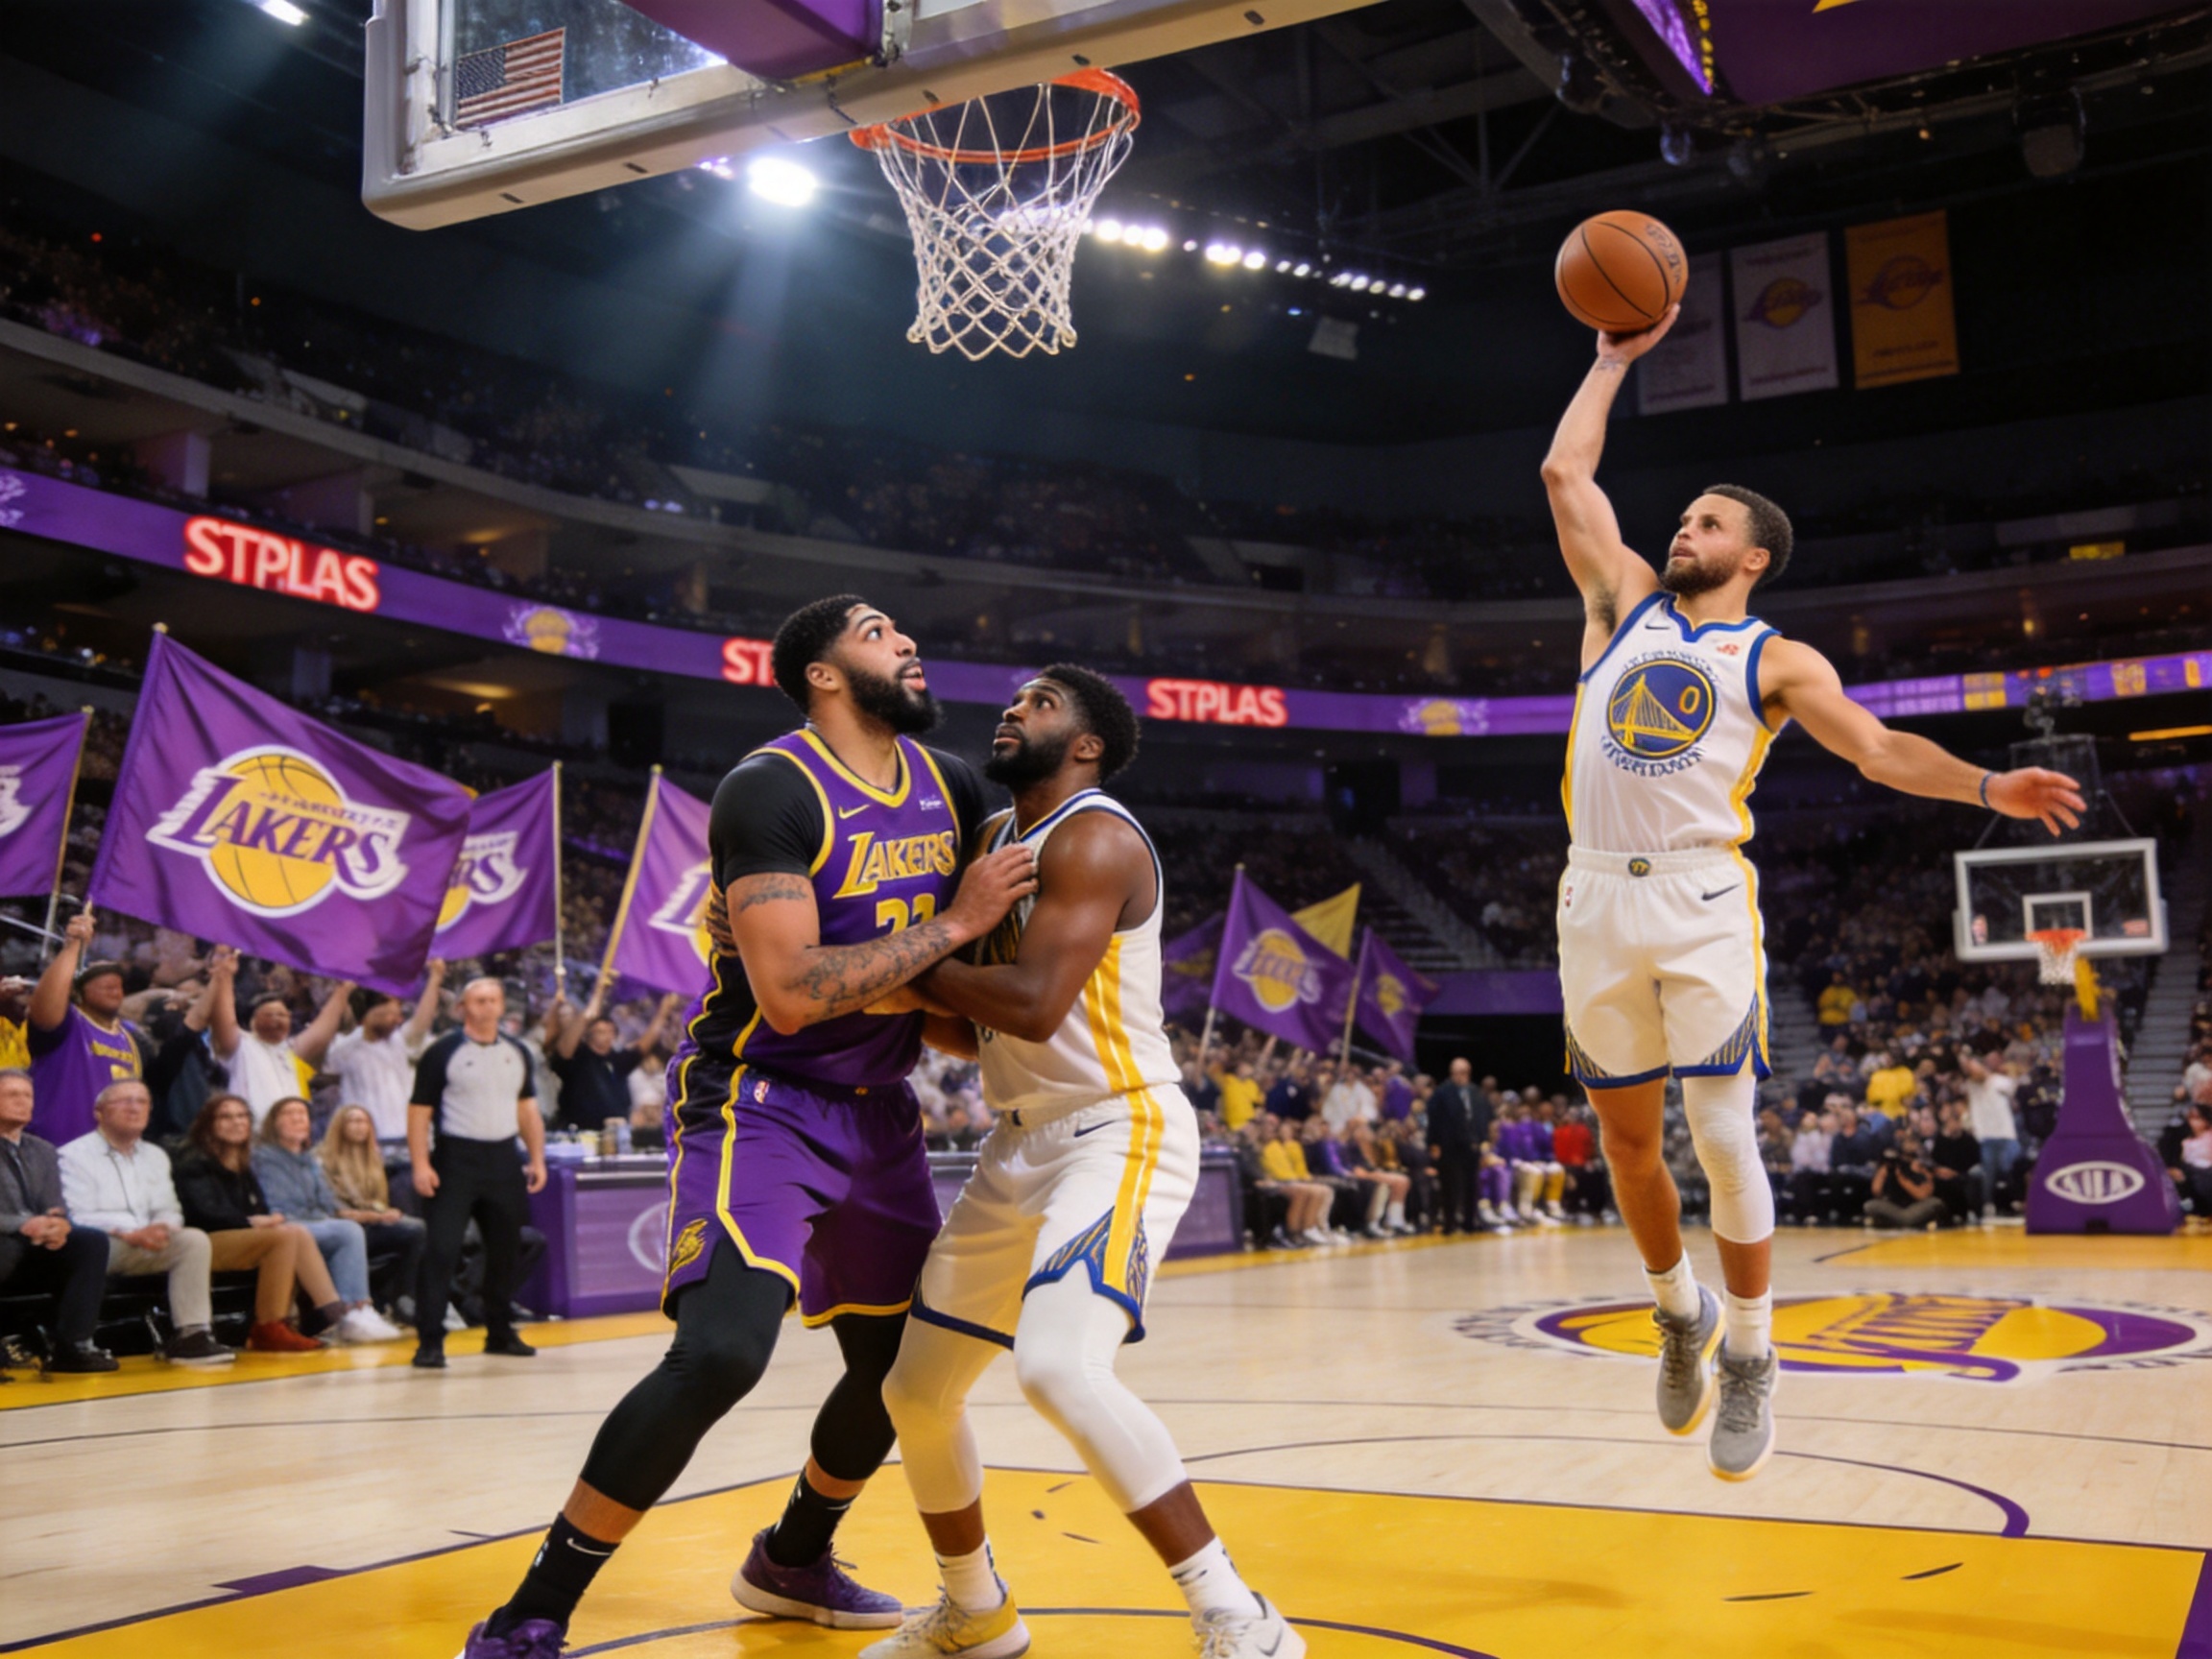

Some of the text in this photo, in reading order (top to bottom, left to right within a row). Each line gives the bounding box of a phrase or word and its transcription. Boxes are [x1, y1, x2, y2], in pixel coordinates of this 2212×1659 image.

[184, 515, 380, 613] STPLAS
[722, 637, 775, 686] ST
[1147, 678, 1287, 728] STPLAS
[1679, 685, 1700, 714] 0
[161, 775, 391, 890] LAKERS
[831, 830, 956, 900] LAKERS
